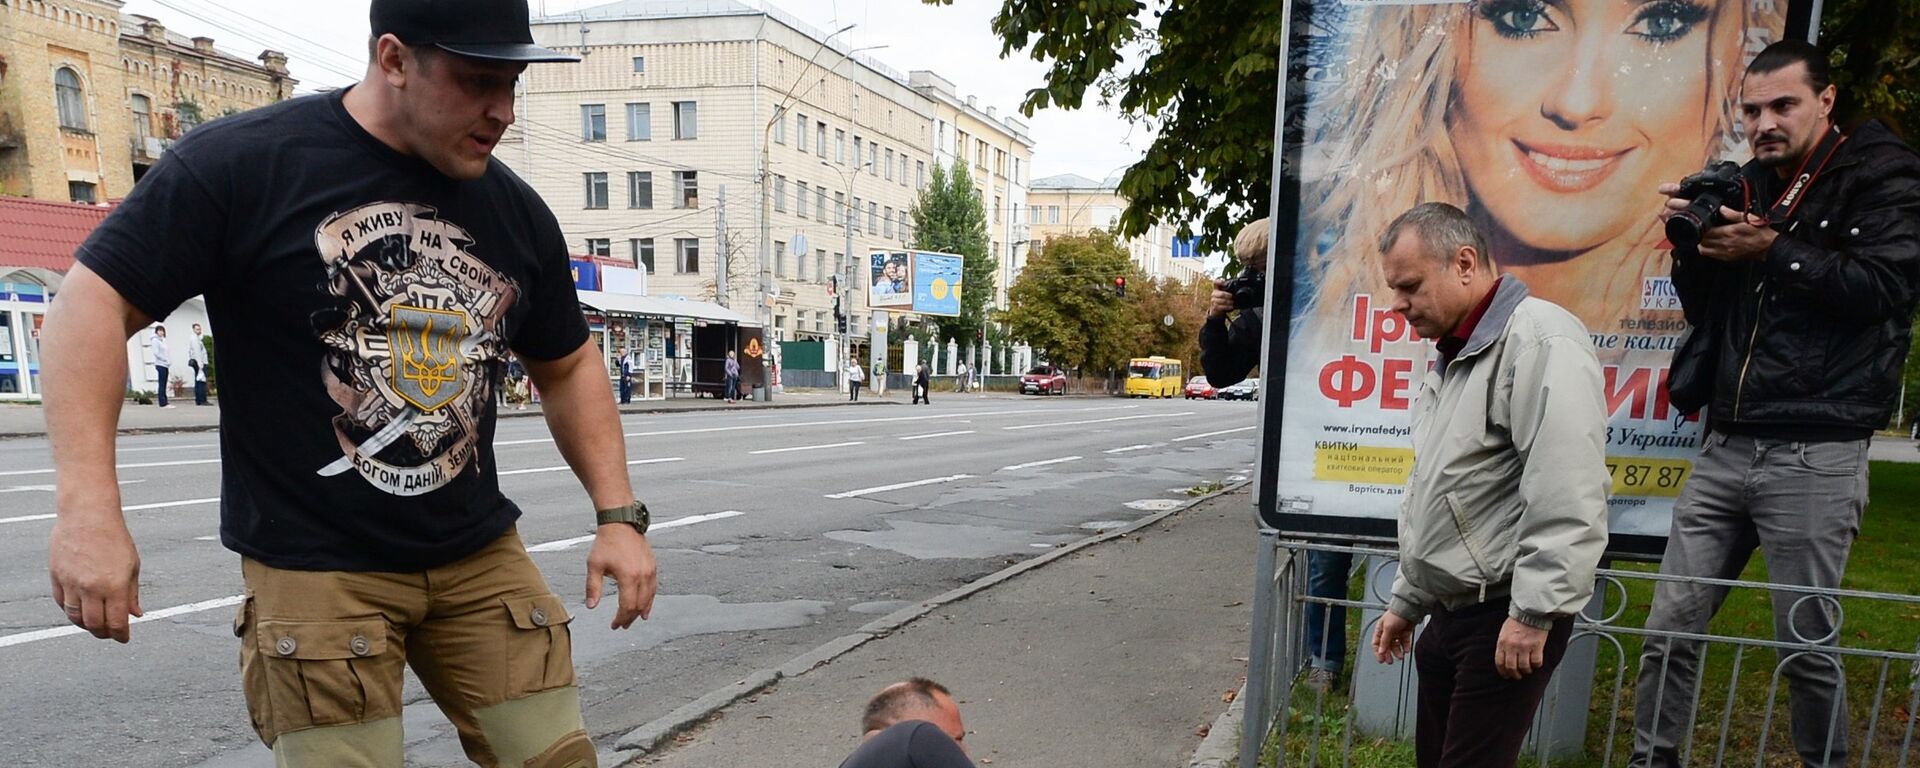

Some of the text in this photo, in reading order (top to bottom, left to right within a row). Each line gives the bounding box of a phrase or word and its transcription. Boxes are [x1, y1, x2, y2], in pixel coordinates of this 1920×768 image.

[1781, 173, 1810, 206] Canon
[341, 228, 355, 247] Я
[354, 211, 403, 238] ЖИВУ
[420, 230, 442, 250] НА
[1643, 298, 1677, 308] УКР
[1353, 296, 1439, 353] Ір
[1618, 316, 1689, 331] телезйо
[1589, 334, 1681, 351] те кали
[1315, 440, 1358, 451] КВИТКИ
[1618, 427, 1696, 450] Україні
[1327, 454, 1404, 463] національний
[353, 452, 400, 487] БОГОМ
[1605, 464, 1685, 488] 7 87 87
[1348, 484, 1405, 495] Вартість дзві
